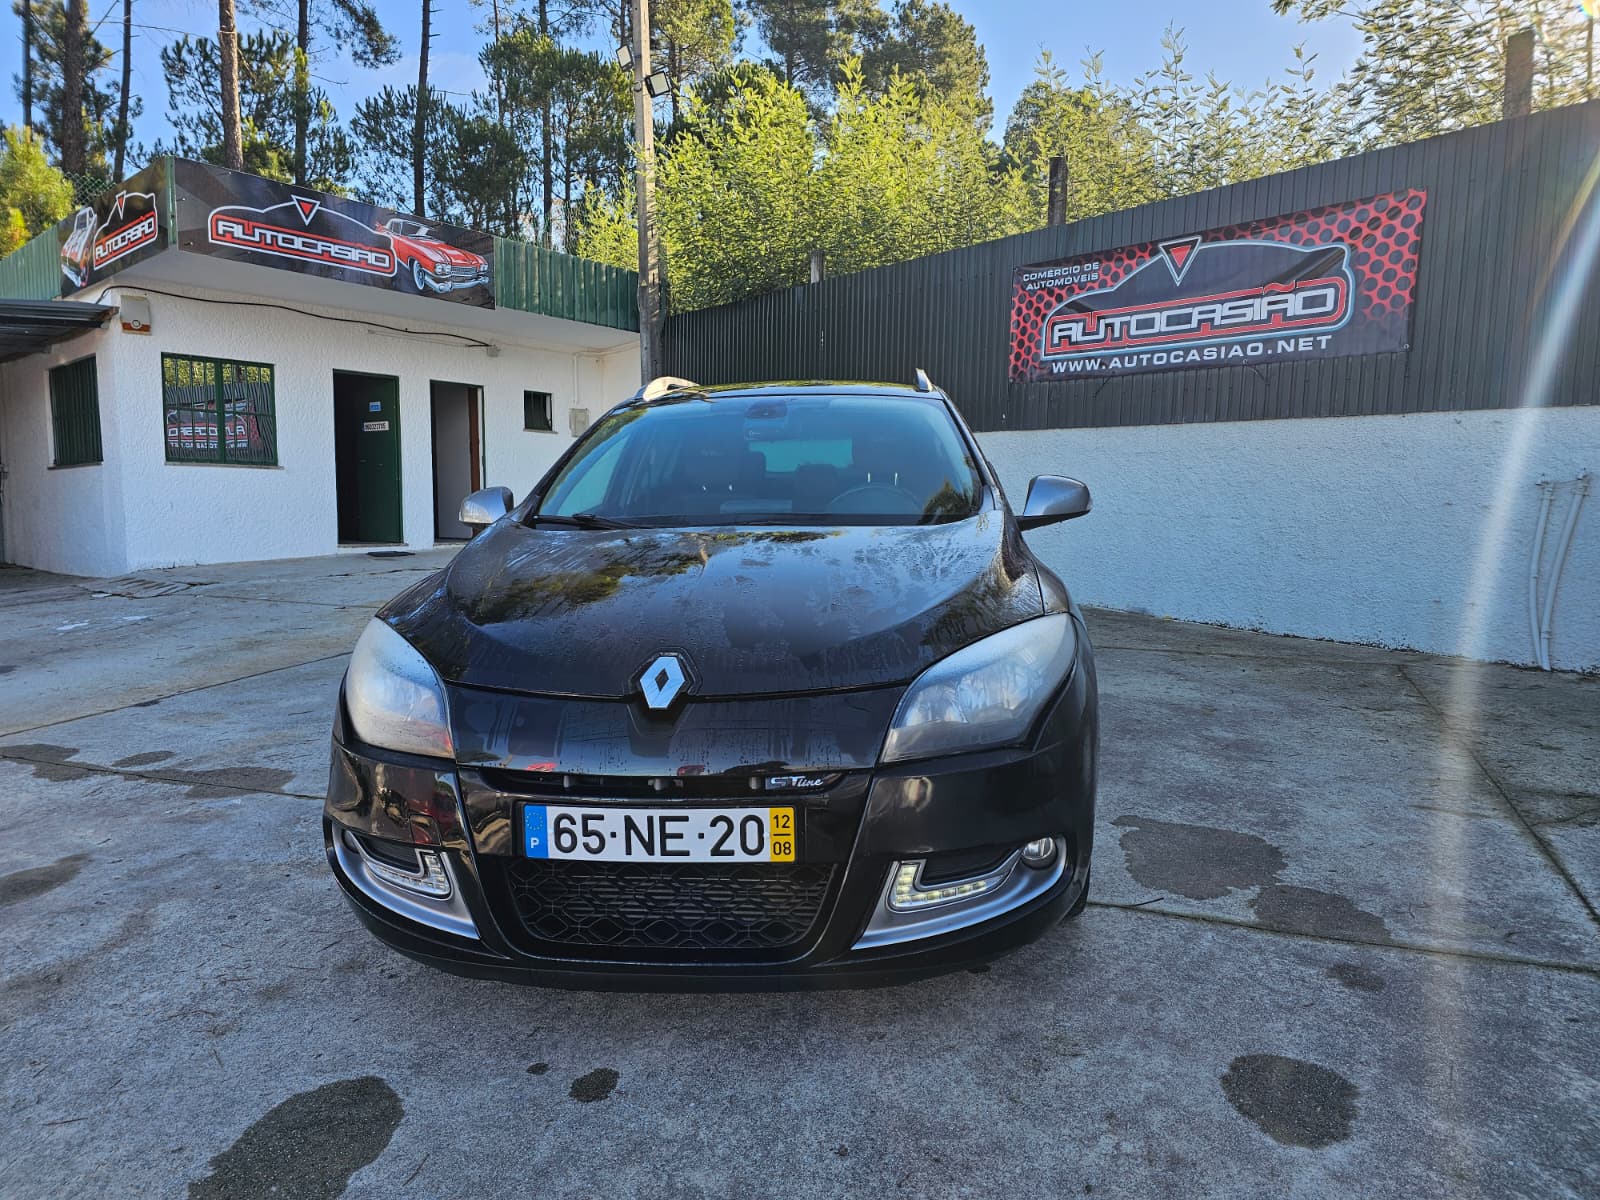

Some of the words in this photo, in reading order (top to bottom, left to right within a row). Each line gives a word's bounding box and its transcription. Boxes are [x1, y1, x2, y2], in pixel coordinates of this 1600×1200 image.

[1084, 262, 1100, 271] DE
[1053, 282, 1336, 344] AUTOCASIÃO
[1052, 335, 1332, 373] WWW.AUTOCASIAO.NET
[773, 815, 790, 829] 12
[530, 837, 540, 849] P
[773, 841, 792, 856] 08
